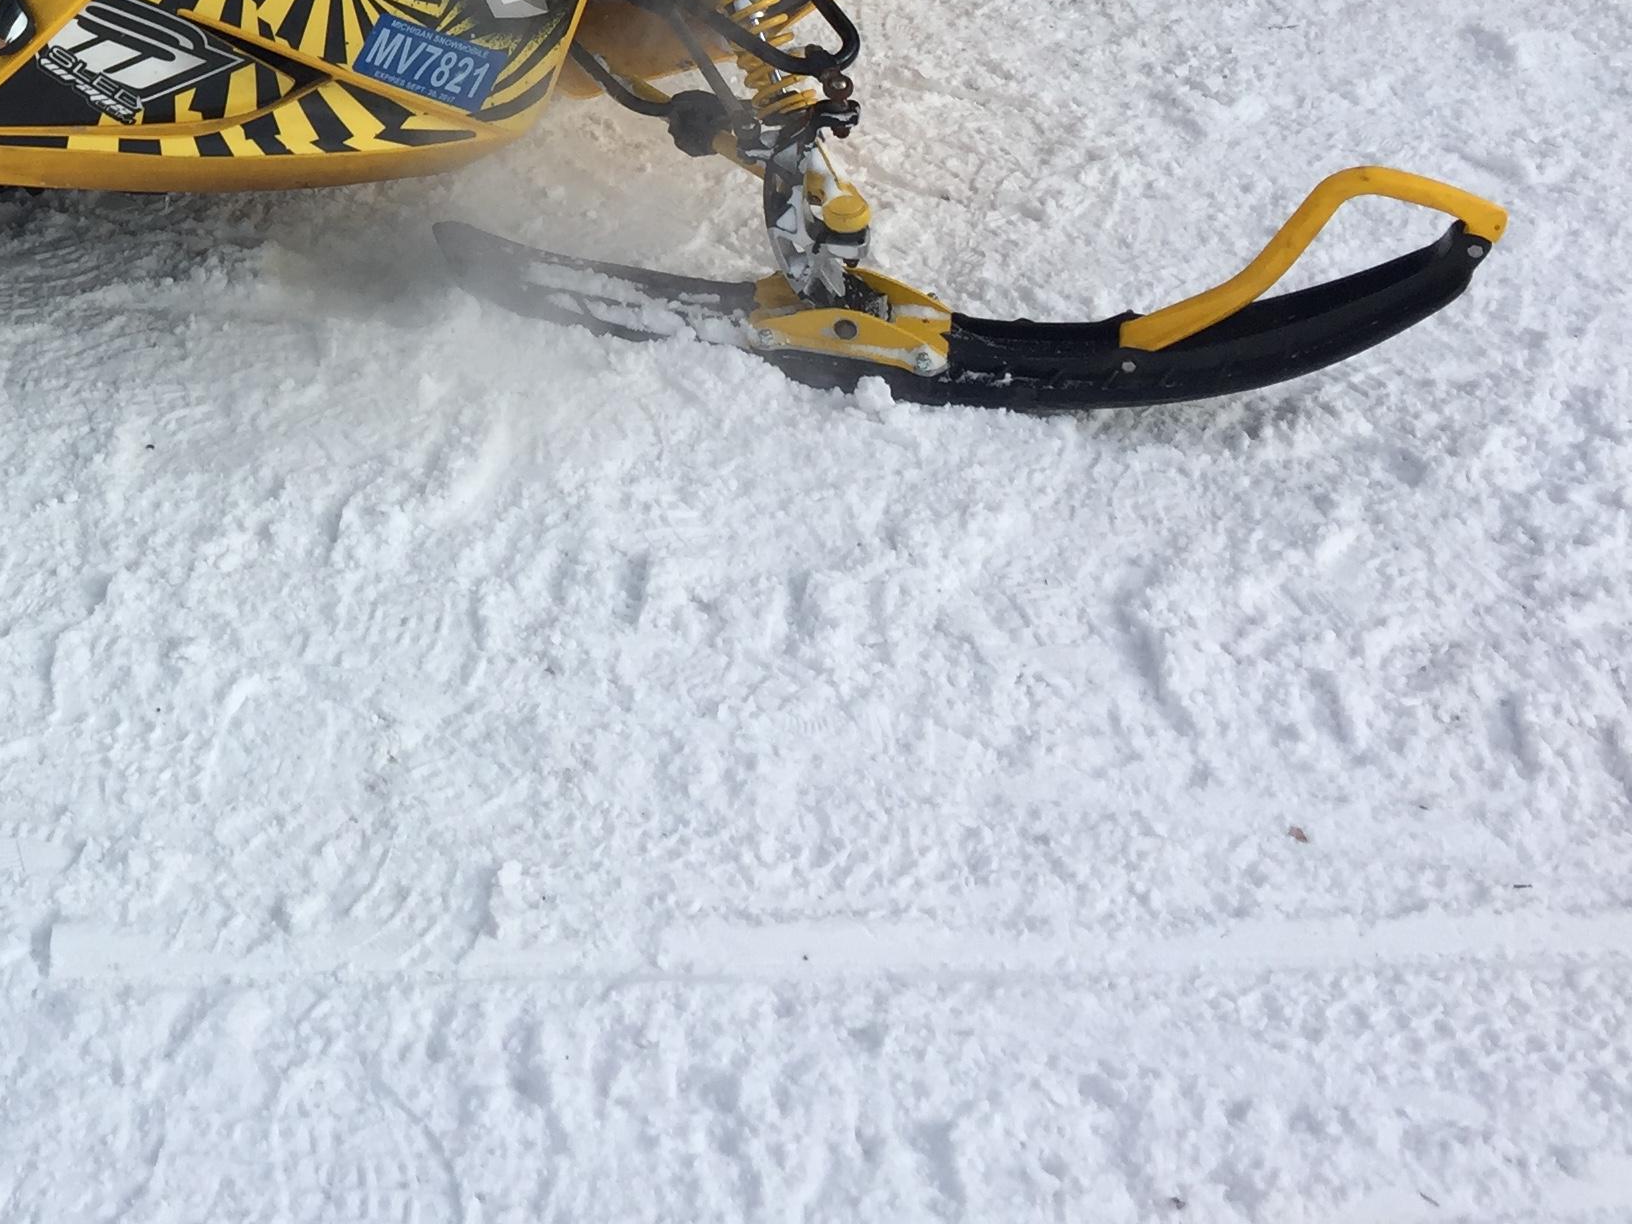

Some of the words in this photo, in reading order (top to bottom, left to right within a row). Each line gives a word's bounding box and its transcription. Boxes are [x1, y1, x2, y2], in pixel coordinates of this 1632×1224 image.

[365, 27, 490, 98] MV7821
[391, 19, 433, 40] MICHIGAN
[432, 33, 490, 58] SNOWMOBILE
[48, 45, 143, 109] SLED
